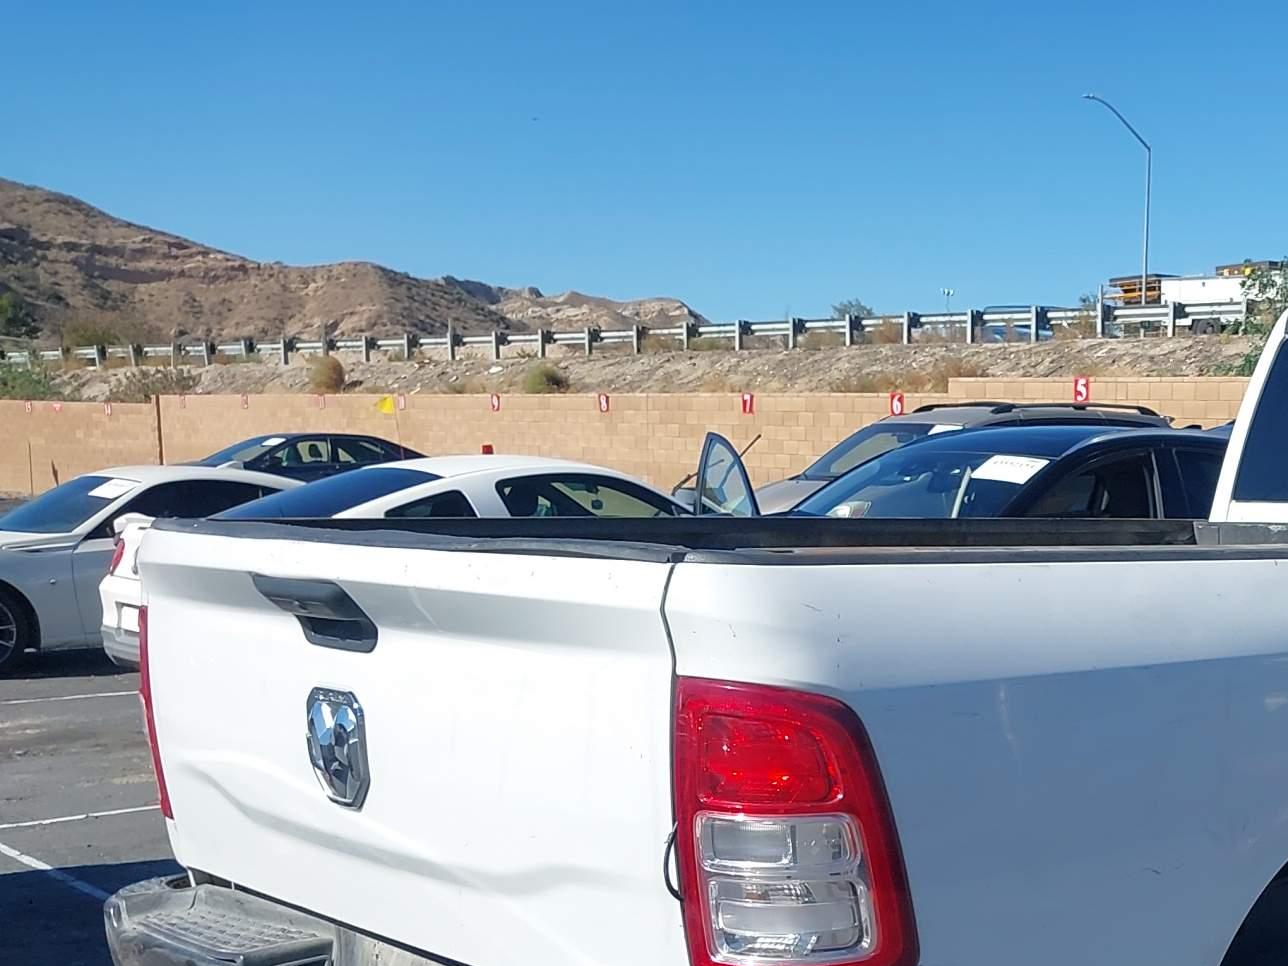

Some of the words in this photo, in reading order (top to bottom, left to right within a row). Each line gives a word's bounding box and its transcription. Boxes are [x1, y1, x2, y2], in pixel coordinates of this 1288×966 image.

[1076, 378, 1087, 401] 5
[600, 394, 608, 412] 8
[892, 394, 902, 415] 6
